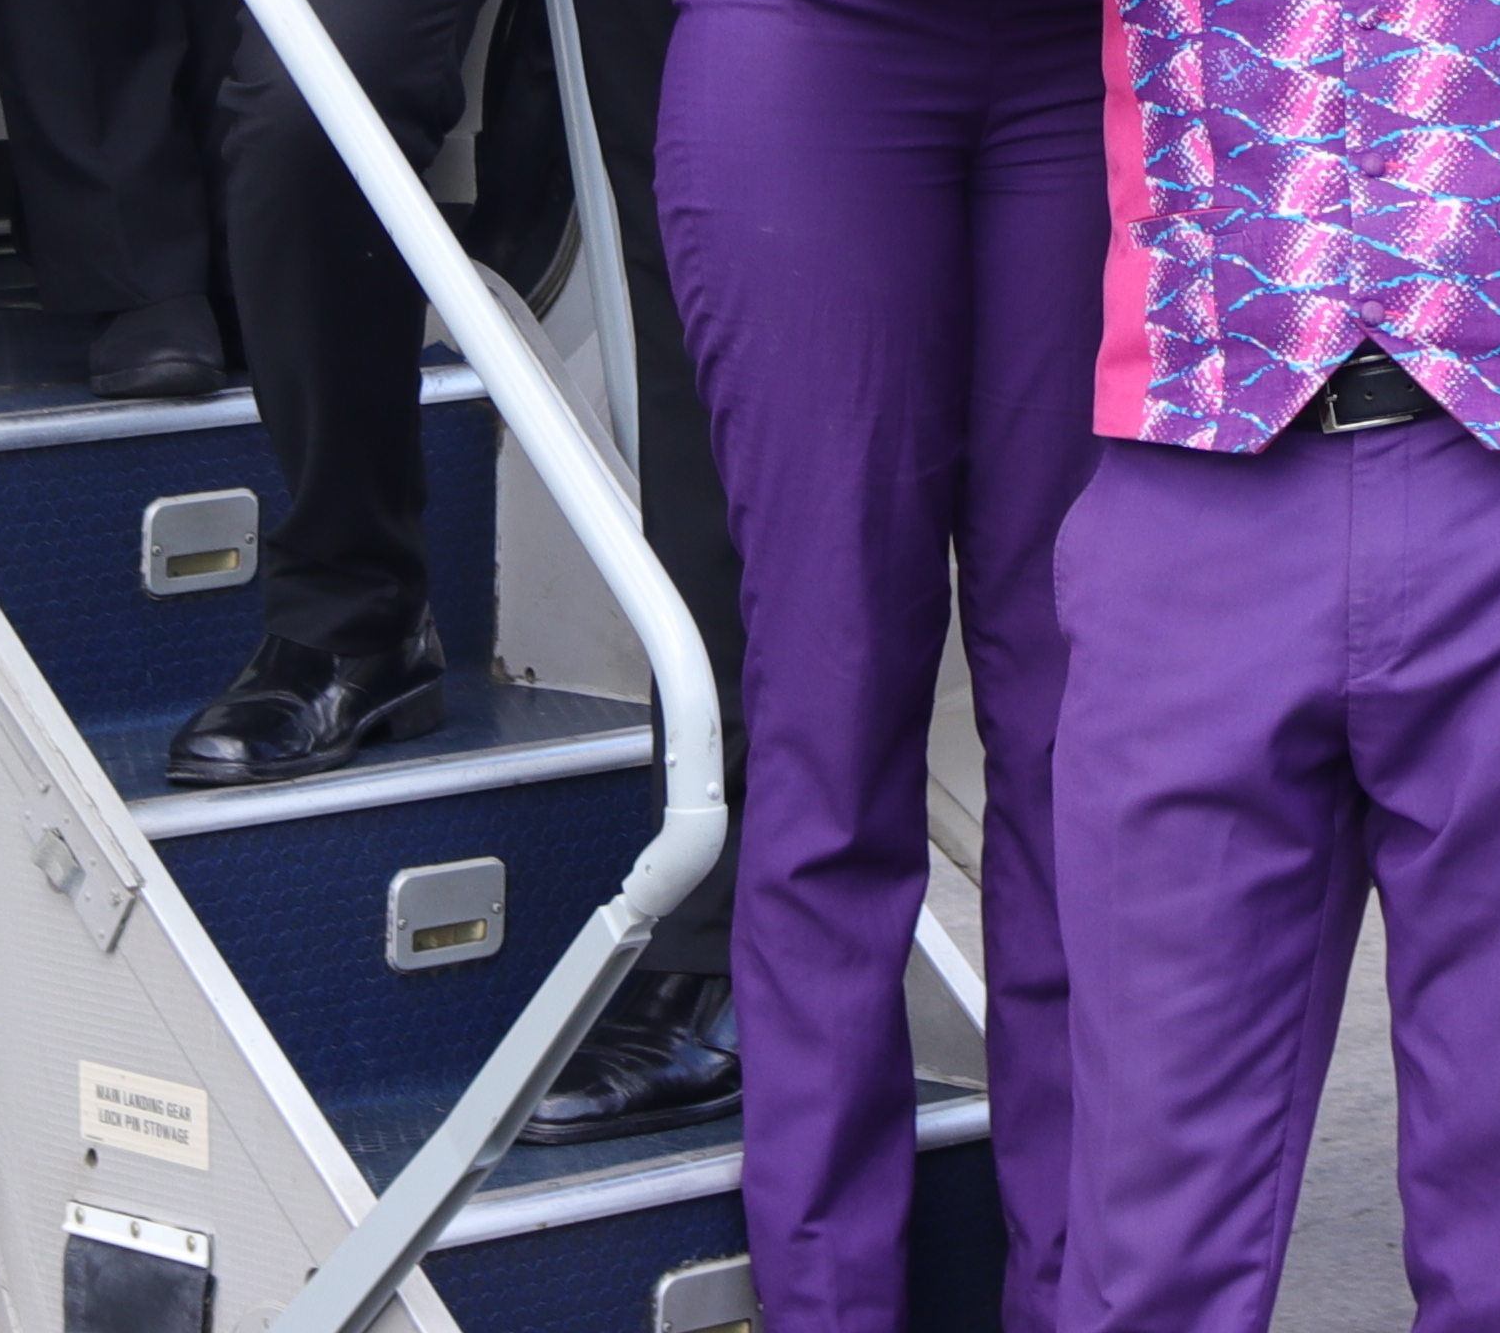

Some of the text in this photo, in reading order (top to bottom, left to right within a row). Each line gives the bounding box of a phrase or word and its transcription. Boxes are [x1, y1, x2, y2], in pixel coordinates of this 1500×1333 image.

[96, 1084, 192, 1123] MAIN LANDING GEAR
[99, 1107, 190, 1146] LOCK PIN STOWAGE
